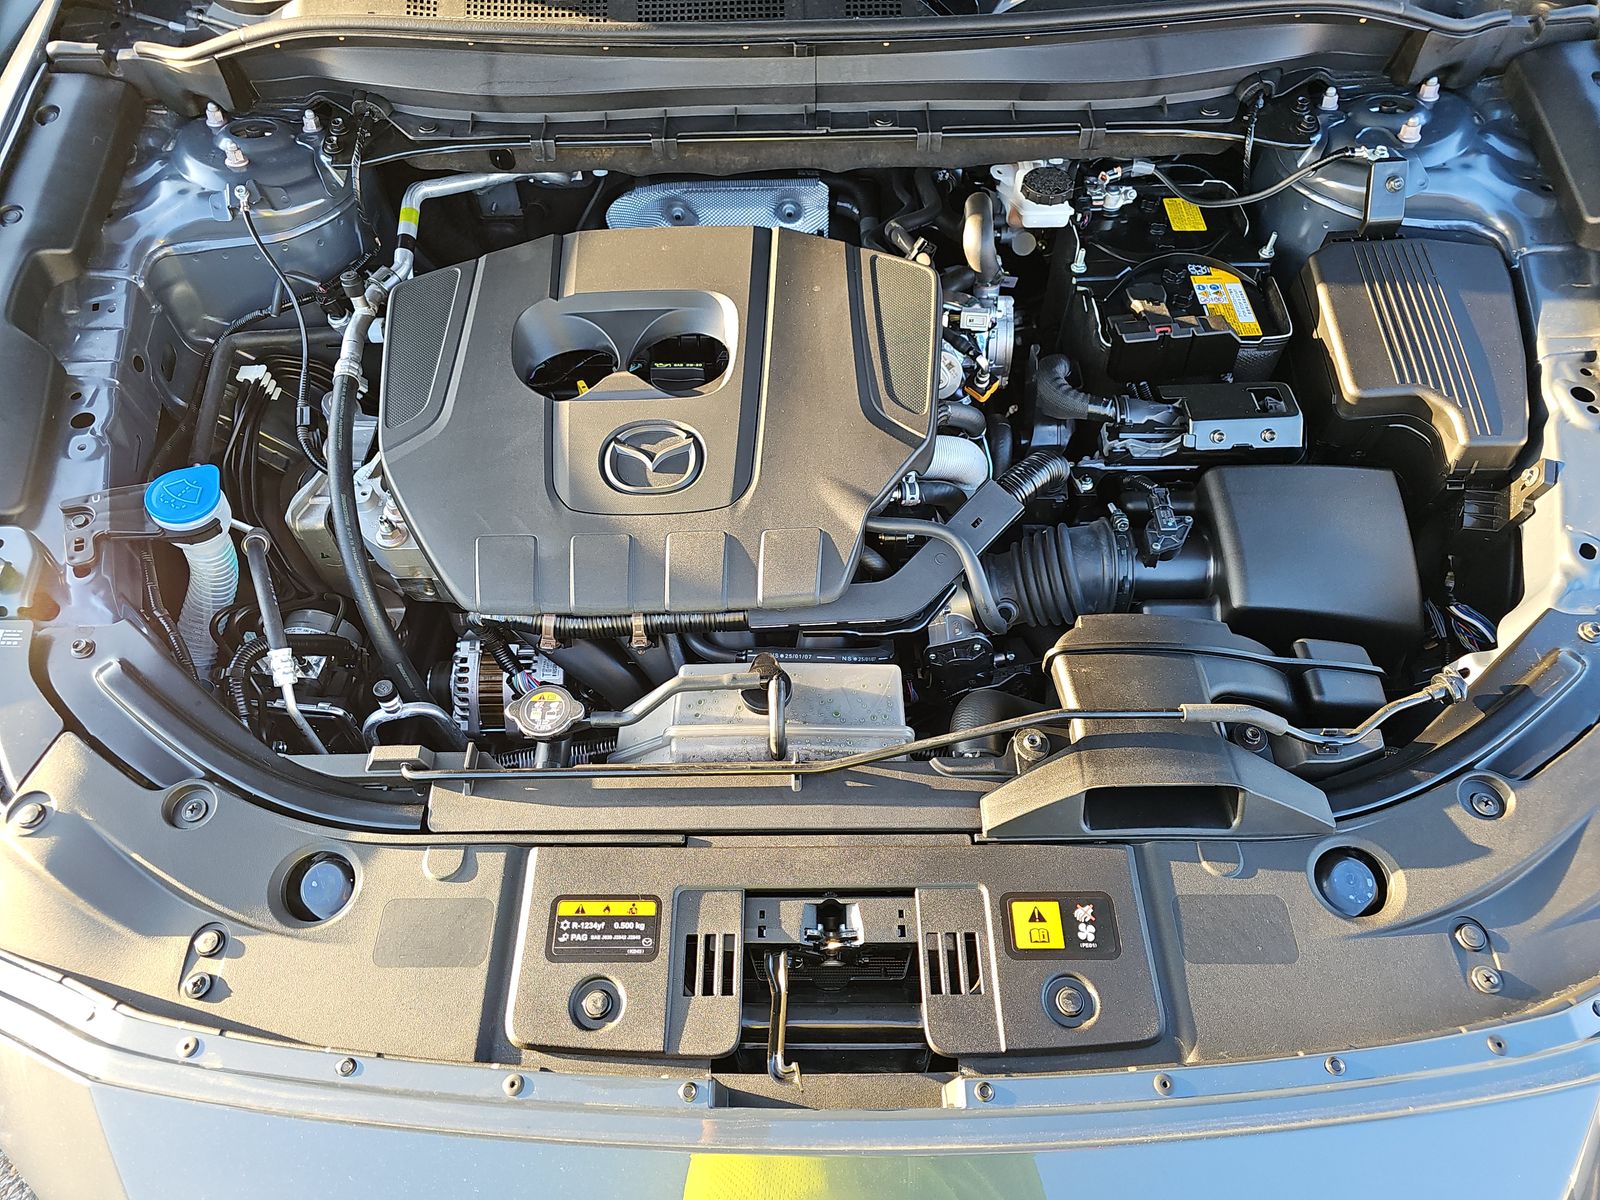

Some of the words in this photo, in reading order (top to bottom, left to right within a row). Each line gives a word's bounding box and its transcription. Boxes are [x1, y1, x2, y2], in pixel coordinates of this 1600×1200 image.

[571, 921, 605, 931] R-1234yf
[614, 921, 634, 929] 0.500
[635, 921, 645, 931] kg
[570, 933, 588, 942] PAG
